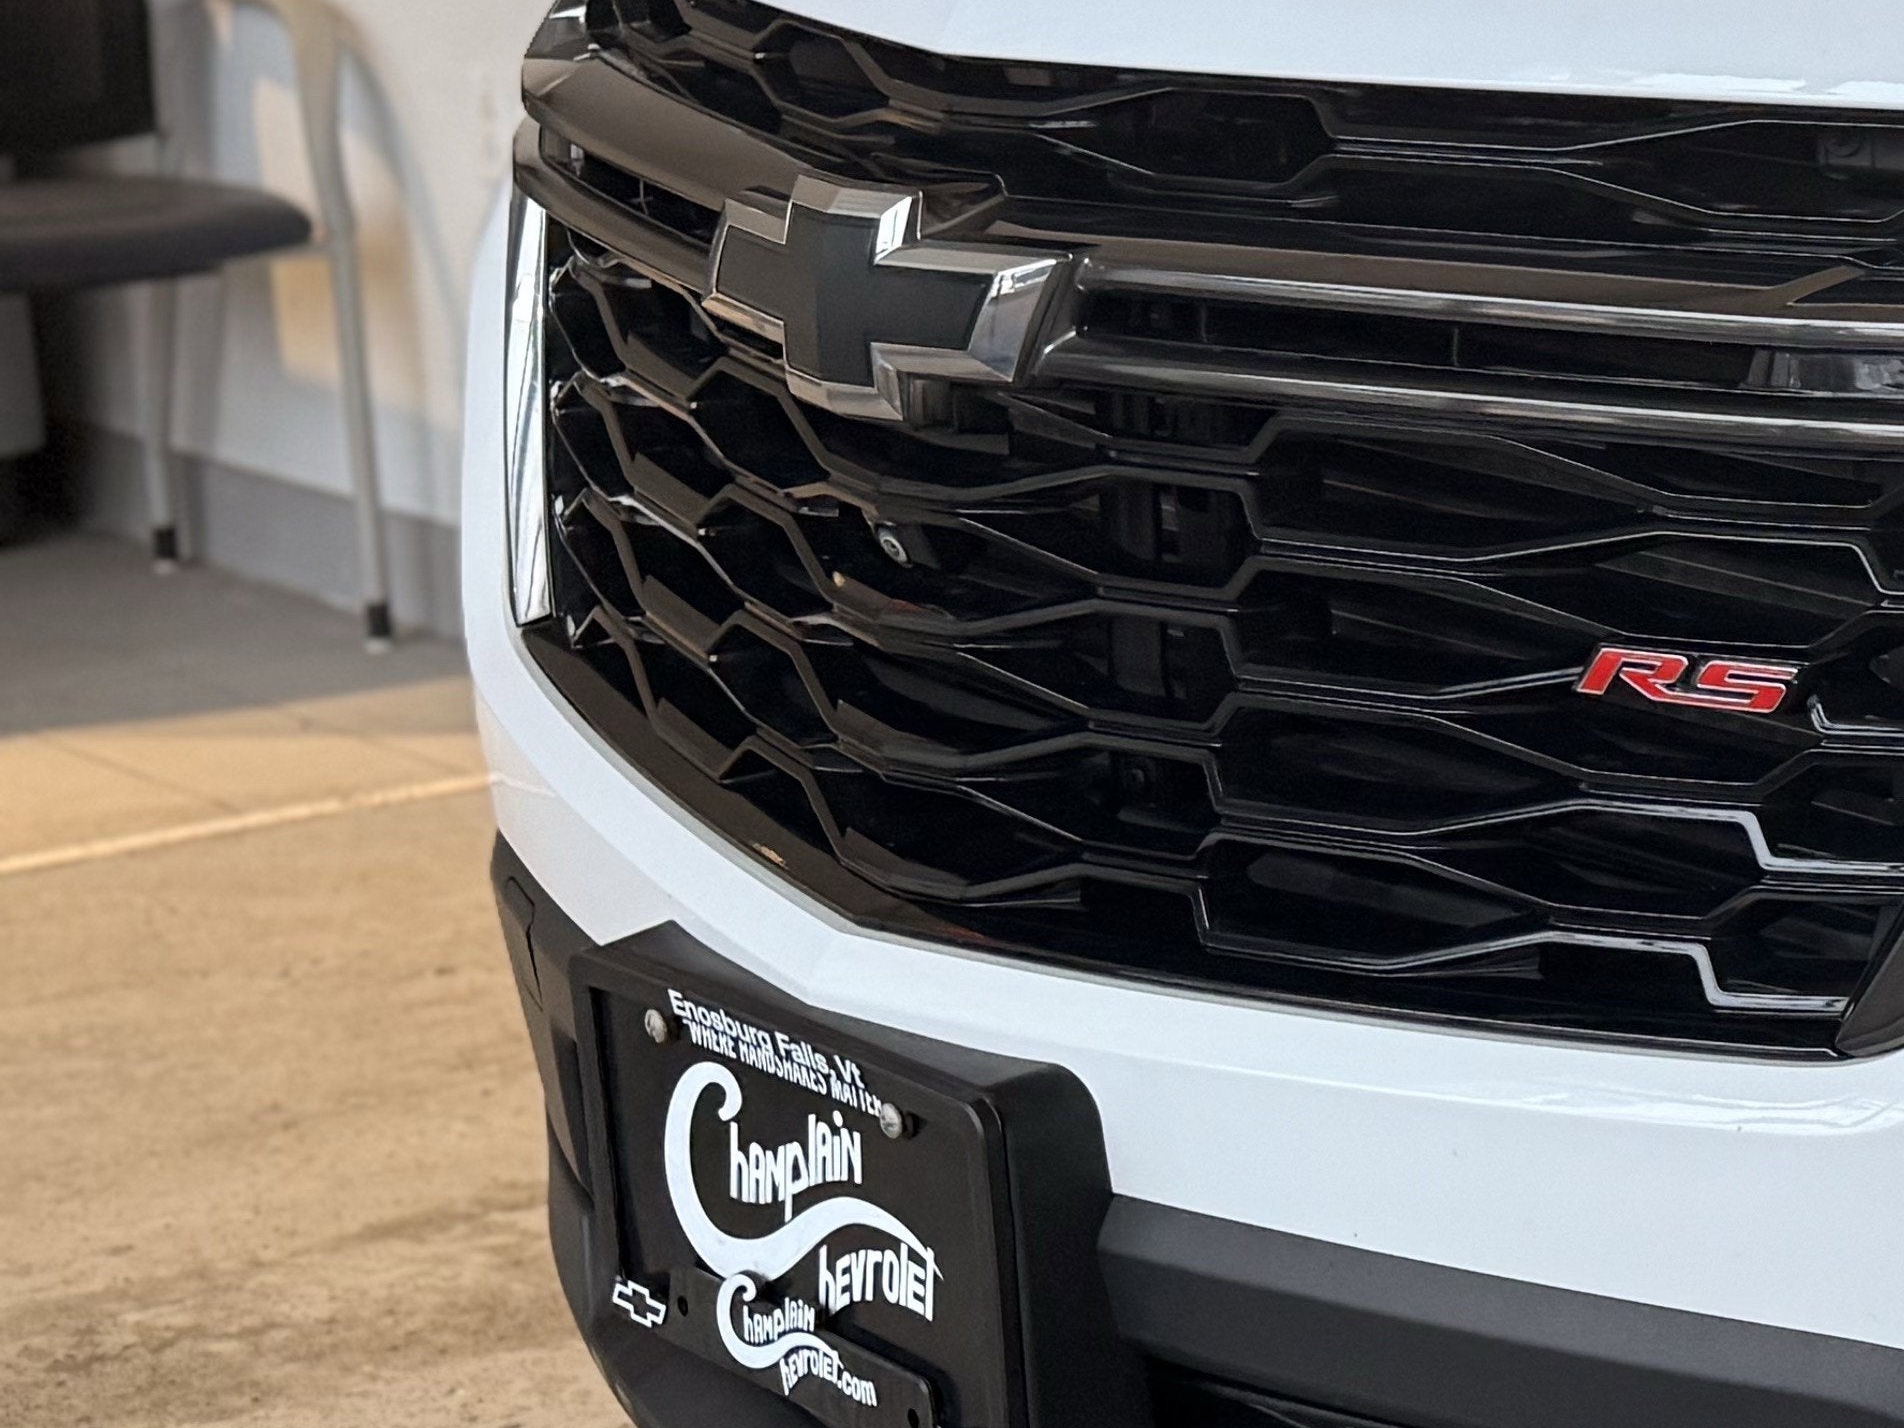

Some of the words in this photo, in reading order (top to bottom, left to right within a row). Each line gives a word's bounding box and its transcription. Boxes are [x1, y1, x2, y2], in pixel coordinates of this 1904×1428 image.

[1577, 647, 1798, 713] RS
[667, 988, 775, 1054] Enosburg
[774, 1030, 837, 1078] Falls,
[833, 1054, 866, 1089] Vt
